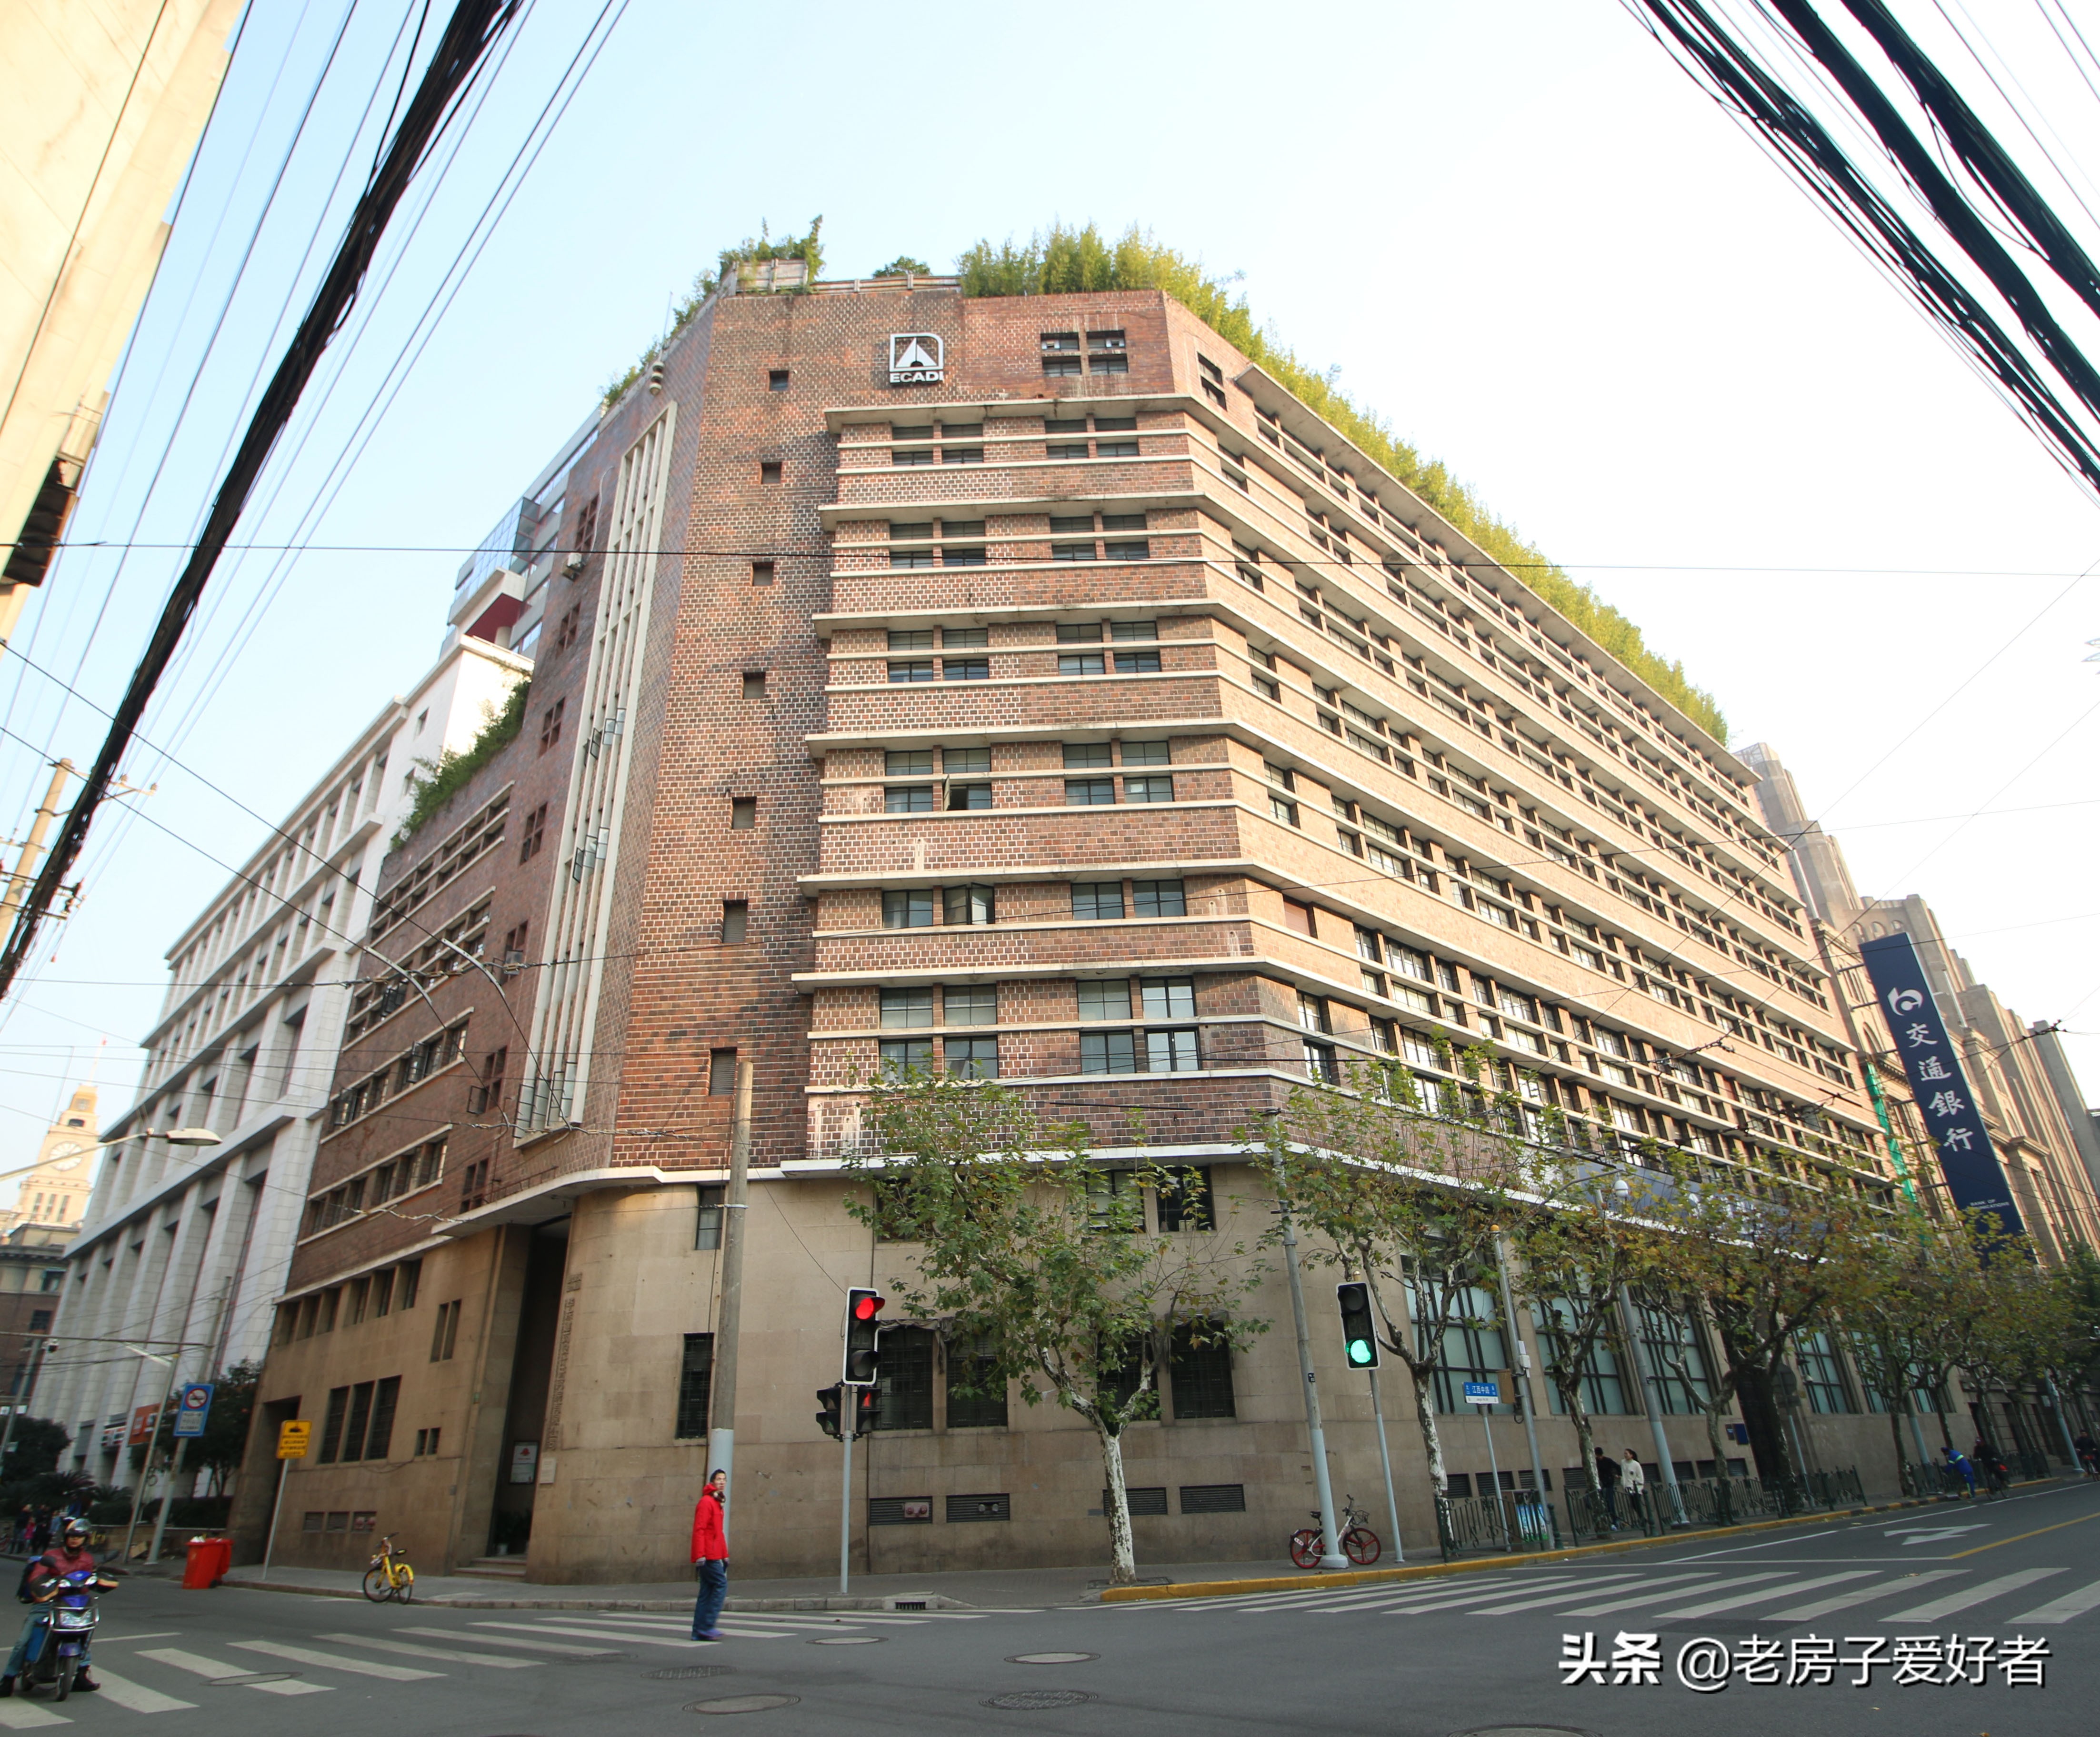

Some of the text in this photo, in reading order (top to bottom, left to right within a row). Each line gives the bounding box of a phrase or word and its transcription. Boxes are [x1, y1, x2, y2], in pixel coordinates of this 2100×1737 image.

[890, 371, 944, 383] ECADI
[1905, 1023, 1974, 1152] 交通銀行
